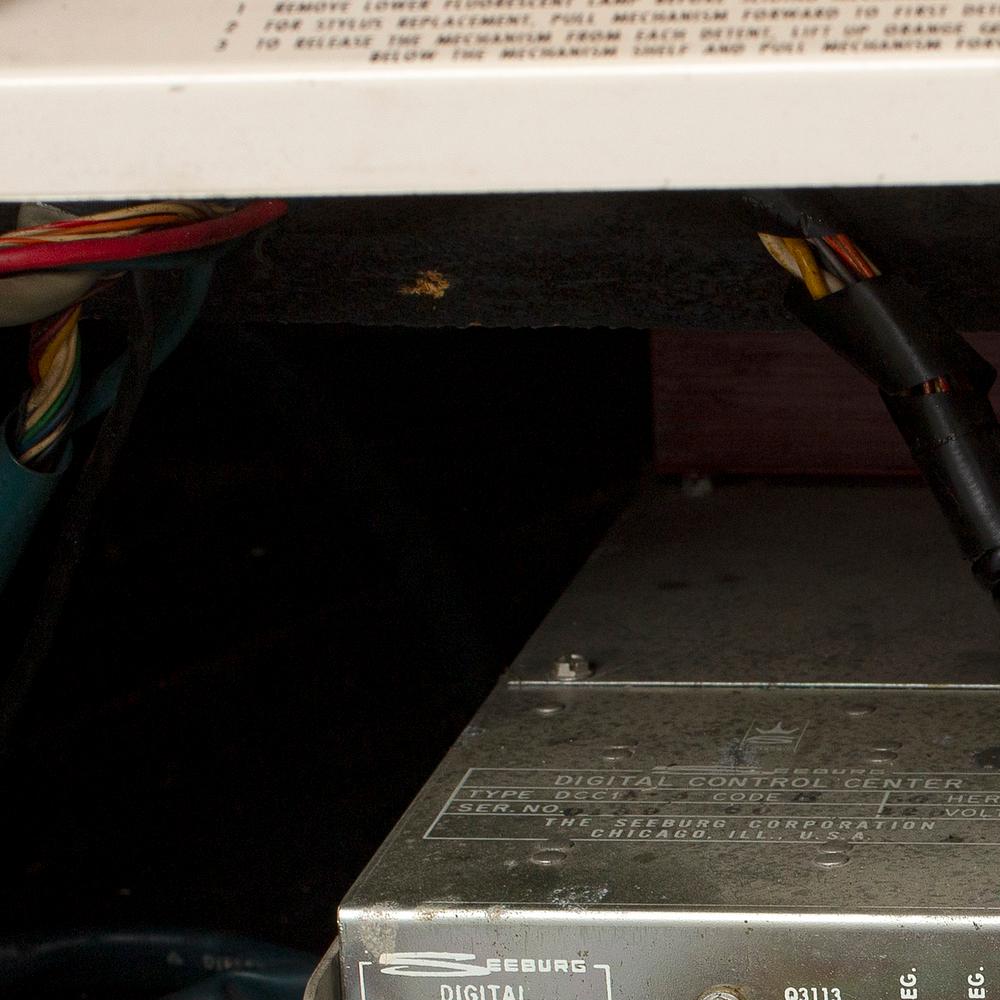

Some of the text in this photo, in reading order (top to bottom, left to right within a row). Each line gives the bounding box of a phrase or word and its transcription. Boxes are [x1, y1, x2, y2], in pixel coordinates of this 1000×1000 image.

[264, 18, 302, 32] FOR
[317, 17, 383, 31] STYLUS
[552, 13, 595, 25] PULL
[612, 11, 728, 24] MECHANISM
[742, 8, 839, 21] FORWARD
[855, 6, 880, 18] TO
[893, 5, 947, 18] FIRST
[255, 37, 281, 51] TO
[294, 35, 372, 49] RELEASE
[388, 34, 420, 47] THE
[436, 32, 551, 47] MECHANISM
[566, 30, 622, 44] FROM
[635, 28, 688, 42] EACH
[790, 25, 831, 38] LIFT
[842, 24, 870, 36] UP
[883, 22, 963, 36] ORANGE
[369, 49, 436, 63] BELOW
[451, 48, 486, 61] THE
[502, 46, 618, 60] MECHANISM
[633, 44, 689, 58] SHELF
[703, 43, 746, 56] AND
[757, 41, 805, 55] PULL
[822, 39, 941, 53] MECHANISM
[553, 775, 964, 791] DIGITAL CONTROL CENTER
[468, 789, 536, 800] TYPE
[712, 791, 783, 801] CODE
[456, 803, 517, 814] SER.
[522, 804, 563, 814] NO.
[544, 817, 938, 831] THE SEEBURG CORPORATION
[799, 832, 873, 841] U.S.A.
